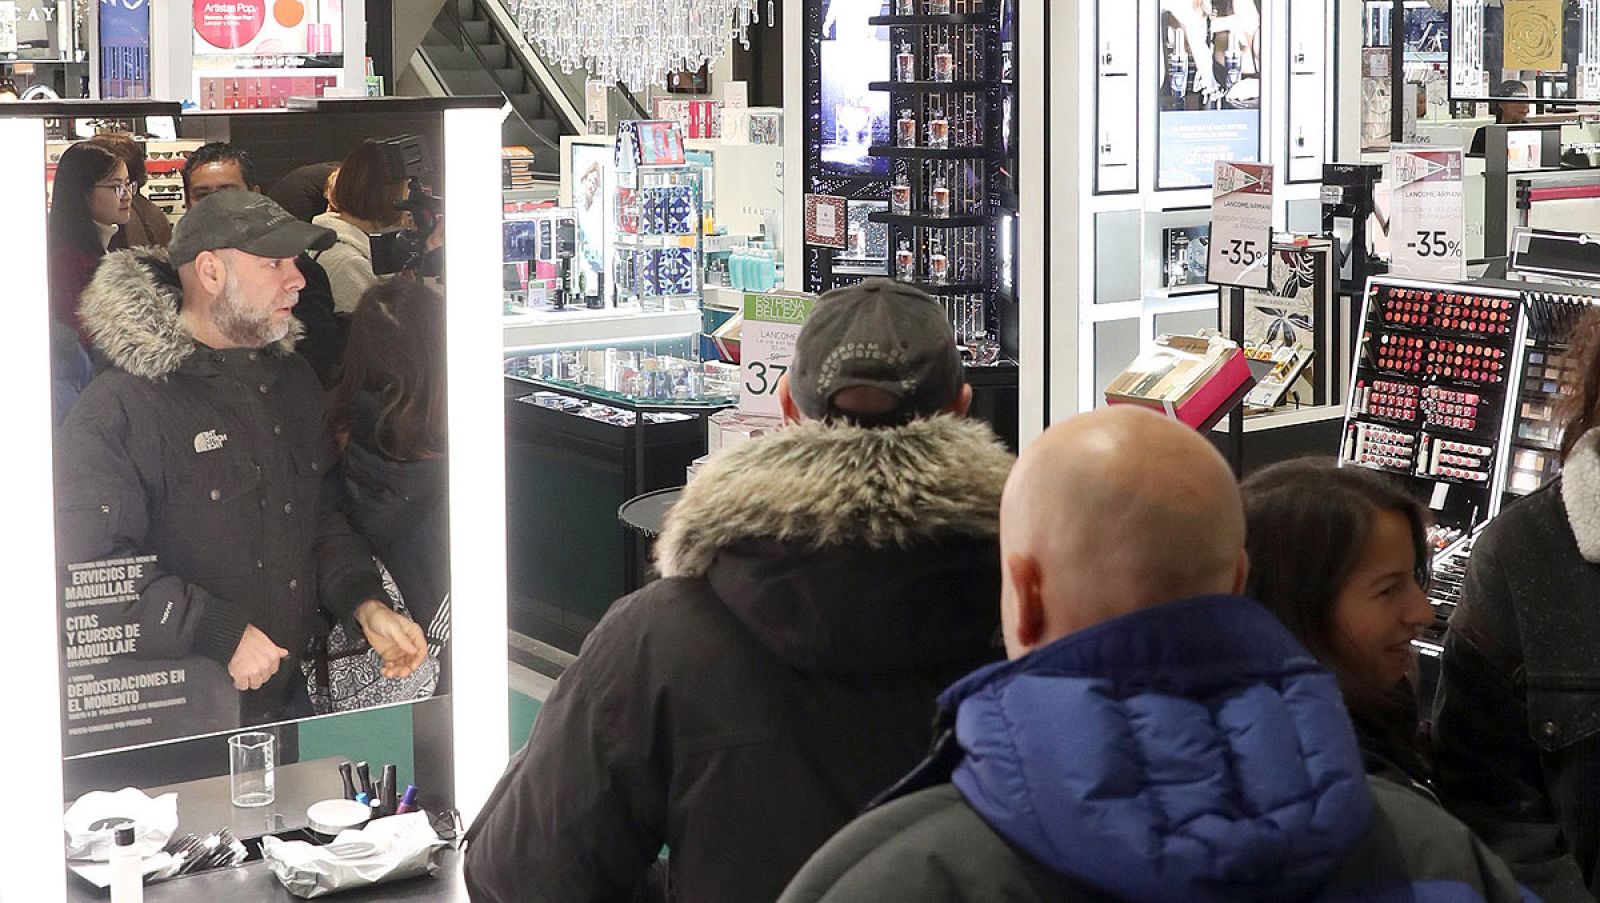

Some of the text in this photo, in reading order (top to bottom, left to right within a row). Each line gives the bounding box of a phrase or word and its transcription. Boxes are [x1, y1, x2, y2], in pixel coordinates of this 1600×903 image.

[1407, 231, 1462, 257] -35%
[756, 295, 804, 309] ESTRENA
[756, 306, 805, 321] BELLEZA
[127, 564, 143, 580] DE
[65, 580, 135, 601] MAQUILLAJE
[66, 614, 98, 632] CITAS
[67, 623, 141, 646] Y CURSOS DE
[67, 639, 136, 661] MAQUILLAJE
[68, 671, 168, 699] DEMOSTRACIONES
[170, 669, 185, 684] EN
[68, 698, 82, 713] EL
[84, 690, 140, 710] MOMENTO
